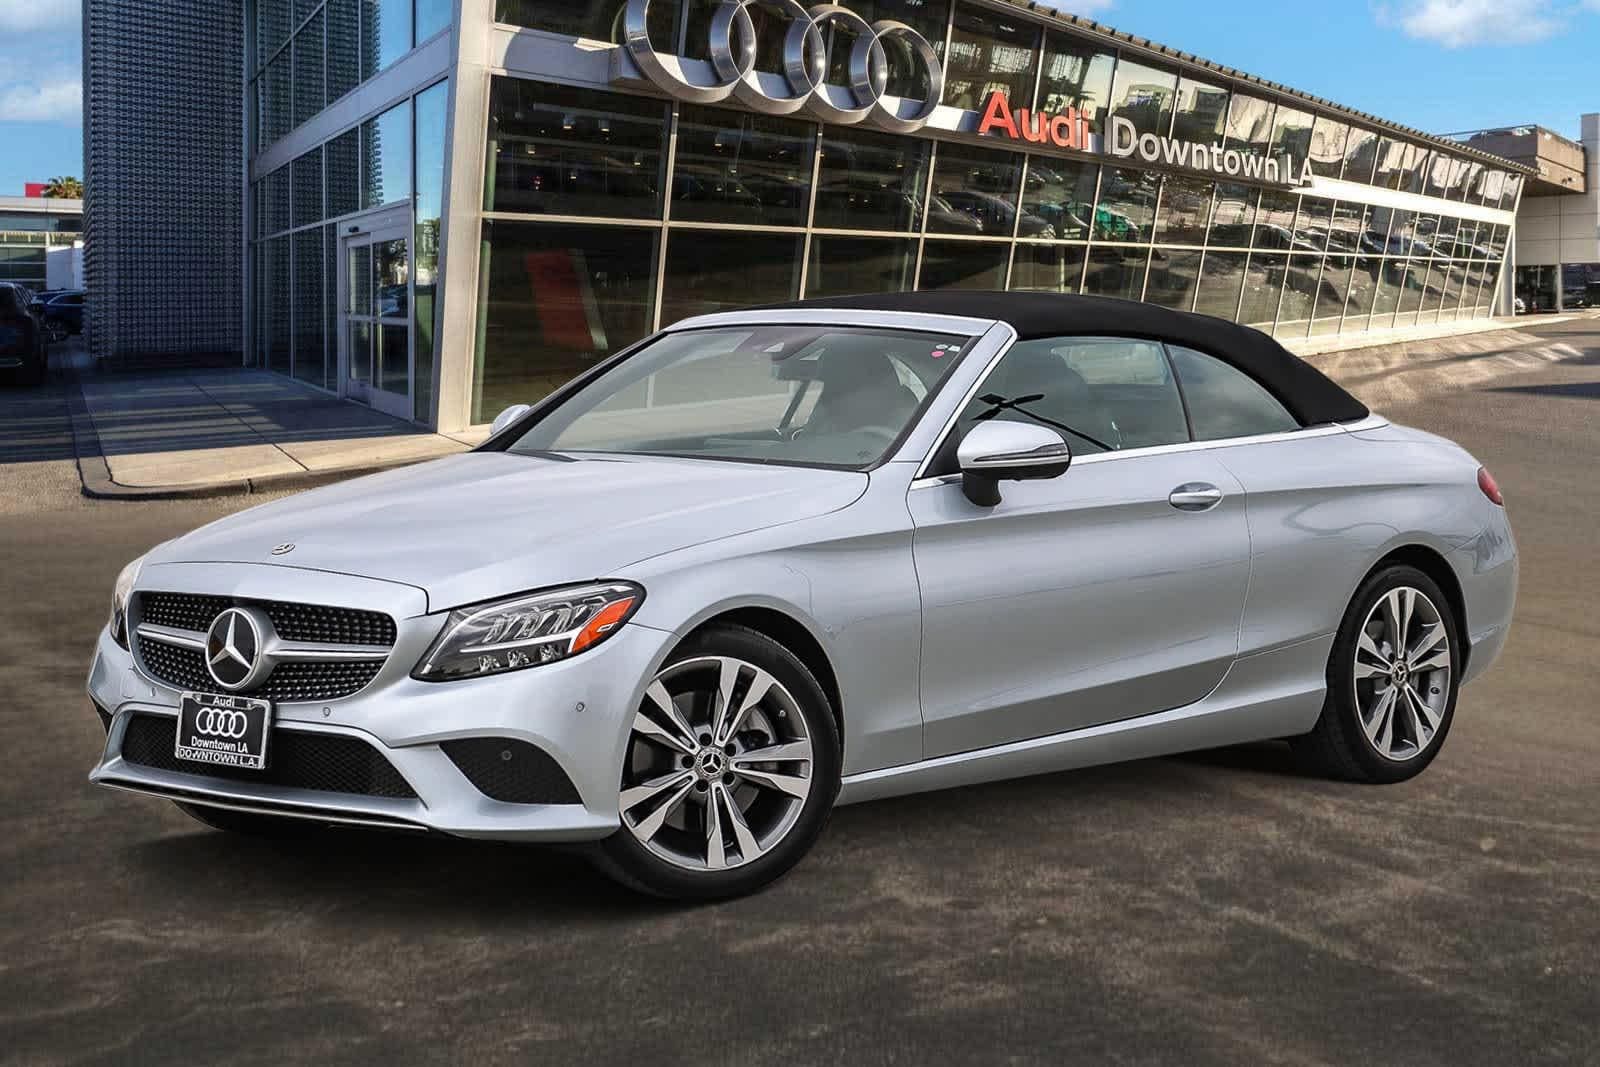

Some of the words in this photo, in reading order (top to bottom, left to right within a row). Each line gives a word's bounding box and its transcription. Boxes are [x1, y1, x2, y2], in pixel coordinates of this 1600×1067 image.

[978, 90, 1089, 150] Audi
[1108, 116, 1279, 182] Downtown
[1288, 156, 1316, 187] LA
[213, 696, 235, 707] Audi
[191, 736, 236, 751] Downtown
[238, 742, 248, 753] LA
[180, 748, 238, 764] DOWNTOWN
